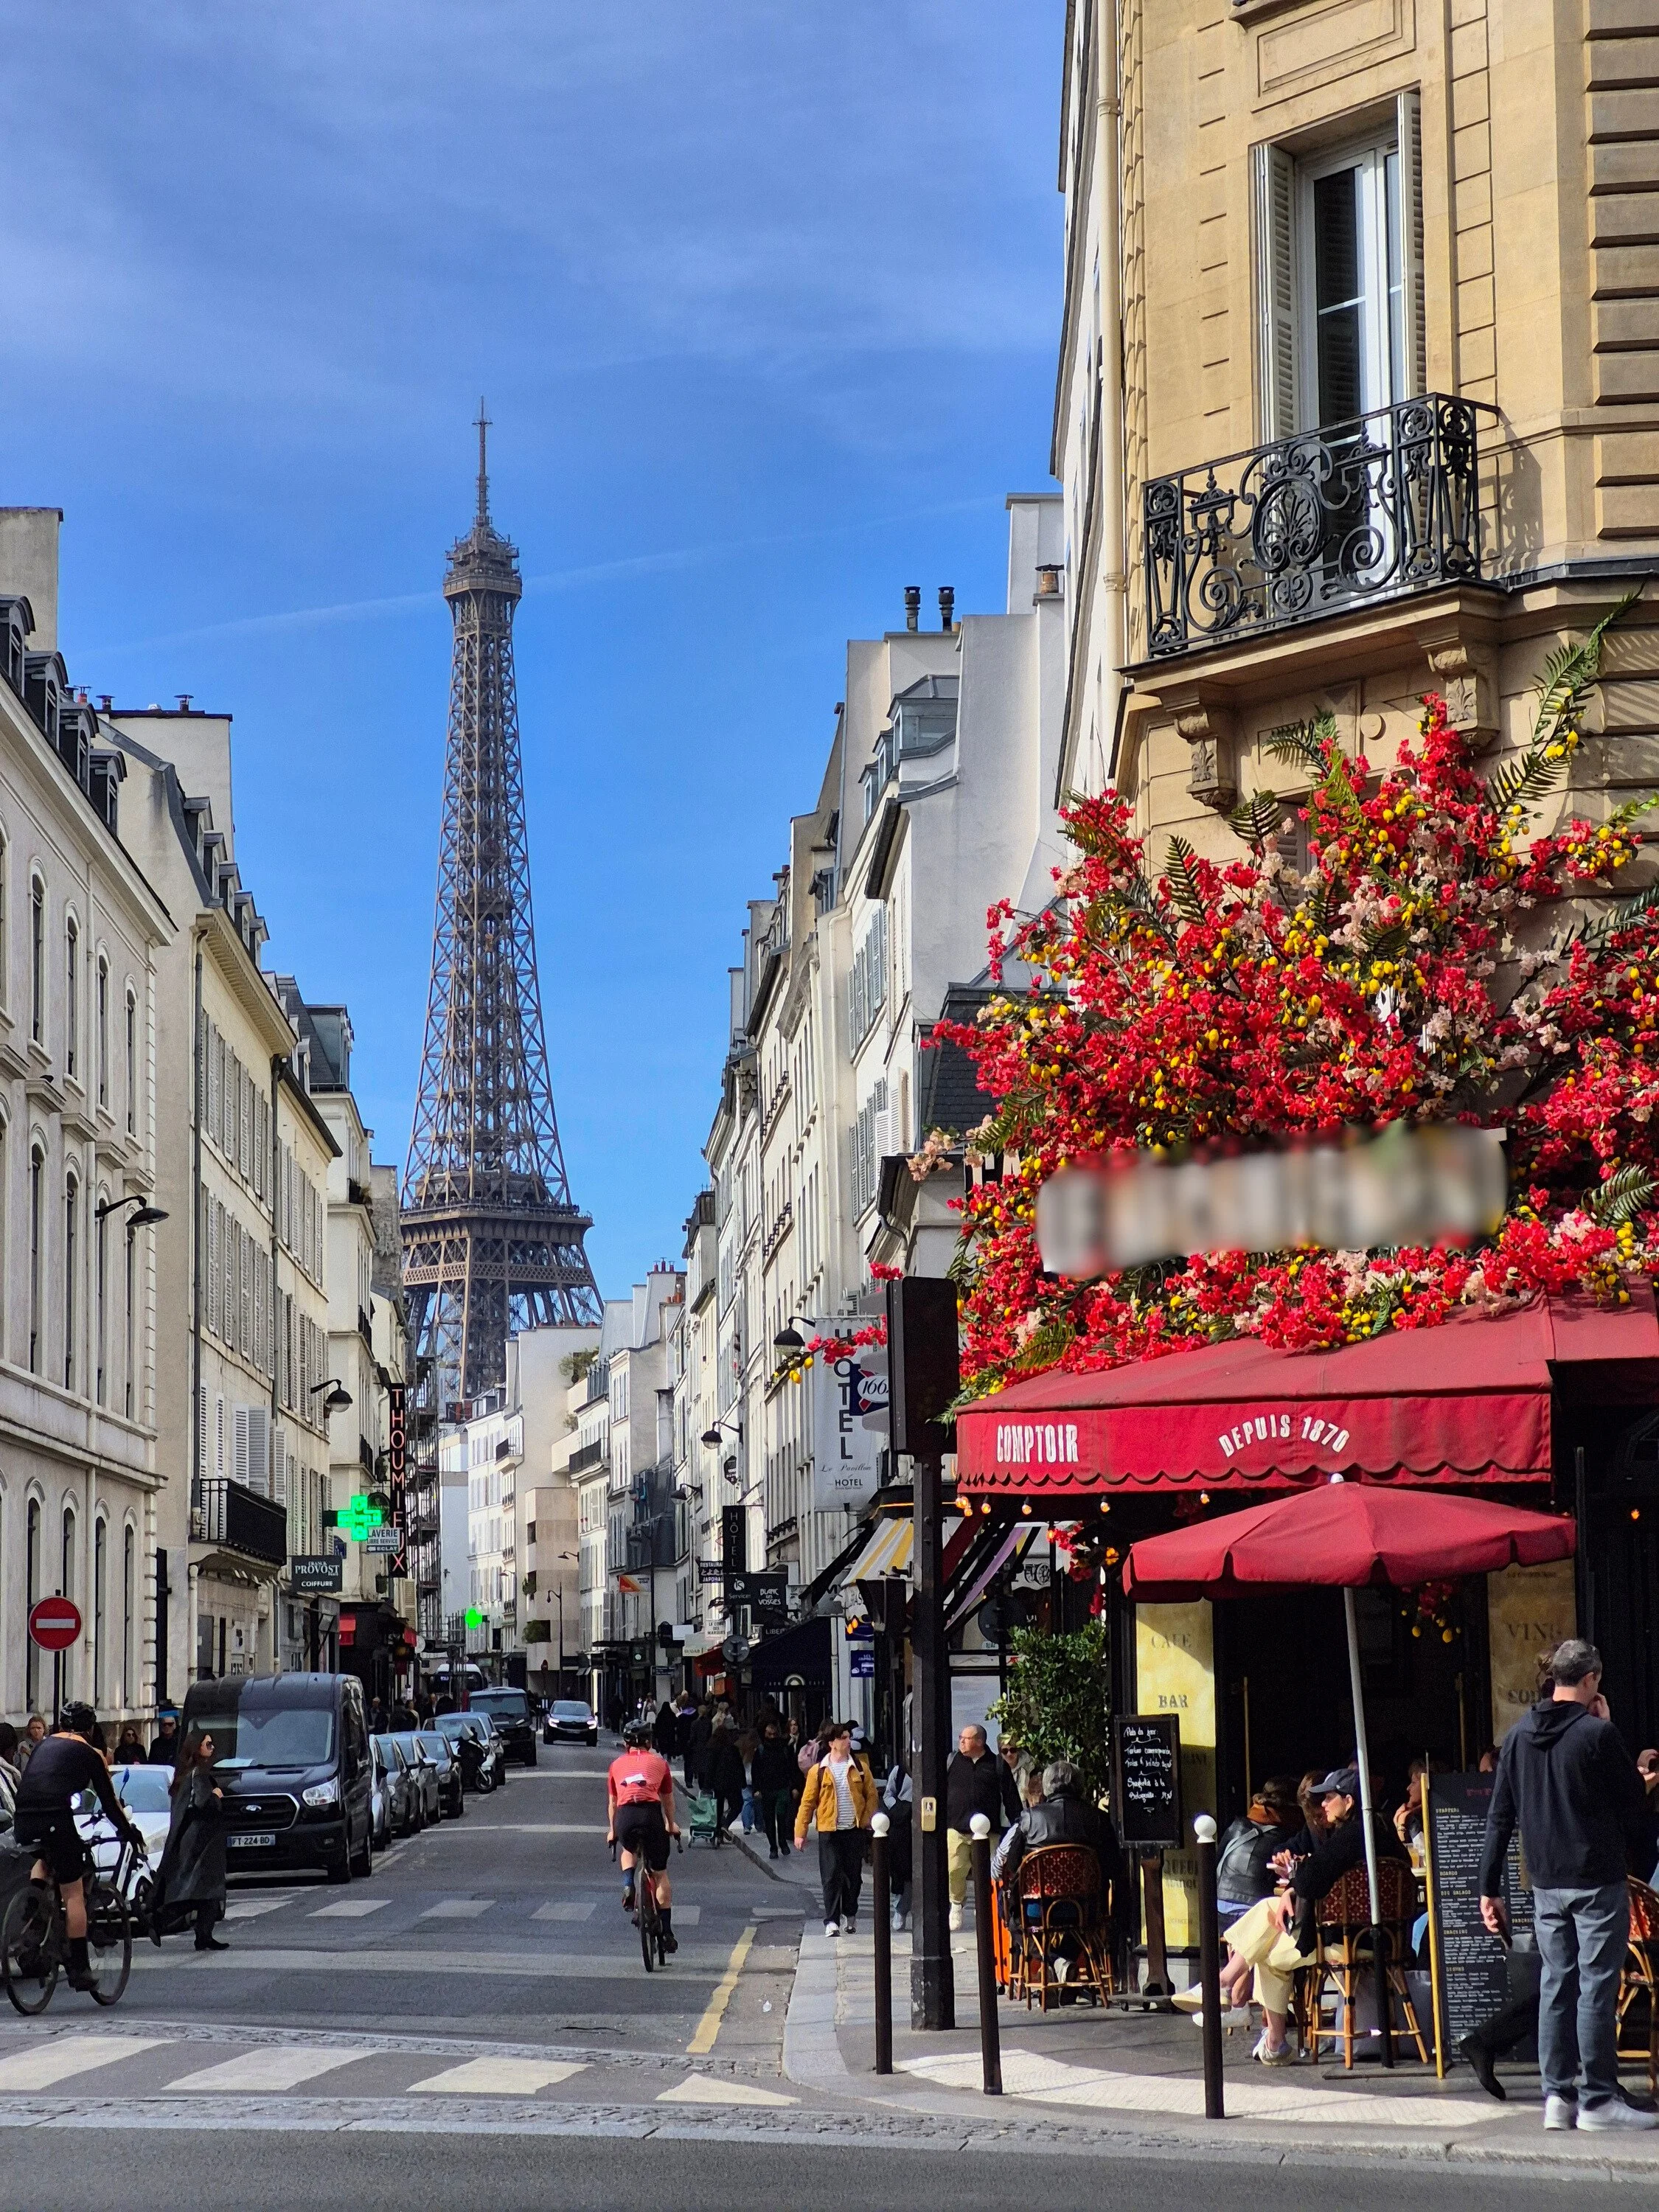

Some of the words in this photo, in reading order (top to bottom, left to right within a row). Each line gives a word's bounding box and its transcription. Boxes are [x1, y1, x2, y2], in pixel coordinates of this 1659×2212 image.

[862, 1377, 889, 1395] 166
[997, 1425, 1079, 1463] COMPTOIR
[1218, 1414, 1291, 1458] DEPUIS
[1301, 1416, 1350, 1453] 1870
[835, 1478, 863, 1487] HOTEL
[730, 1512, 738, 1567] HÔTEL
[295, 1565, 340, 1575] PROVOST
[1158, 1694, 1189, 1708] BAR
